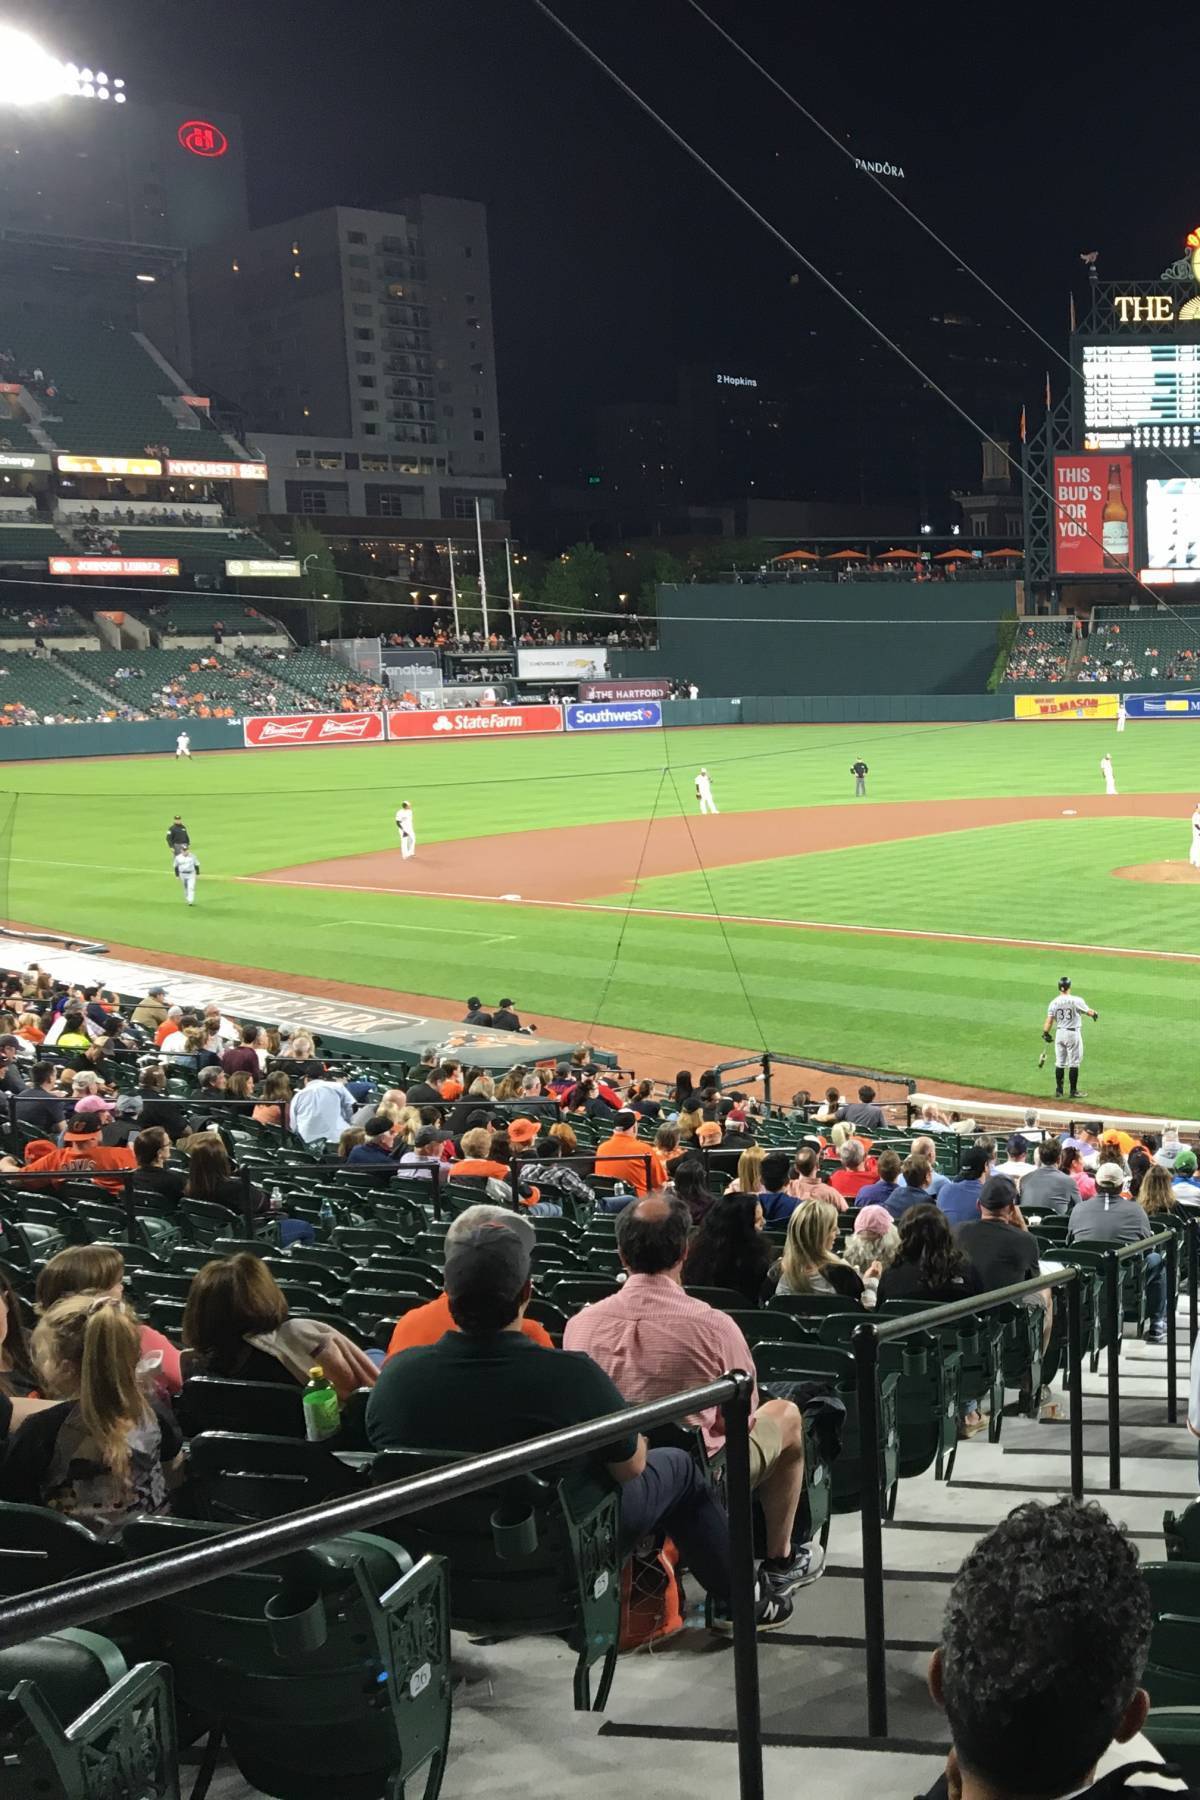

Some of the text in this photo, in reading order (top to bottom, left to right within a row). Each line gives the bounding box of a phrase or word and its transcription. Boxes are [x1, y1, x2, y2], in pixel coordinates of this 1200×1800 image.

[855, 158, 905, 178] PANDORA
[1115, 296, 1174, 322] THE
[716, 374, 757, 387] 2 Hopkins
[1058, 467, 1091, 482] THIS
[1058, 486, 1102, 501] BUD'S
[1059, 503, 1087, 519] FOR
[380, 662, 433, 676] Fanatics
[596, 688, 664, 699] THE HARTFORD
[576, 708, 643, 724] Southwest
[1055, 1008, 1073, 1021] 33
[414, 1672, 427, 1692] 26
